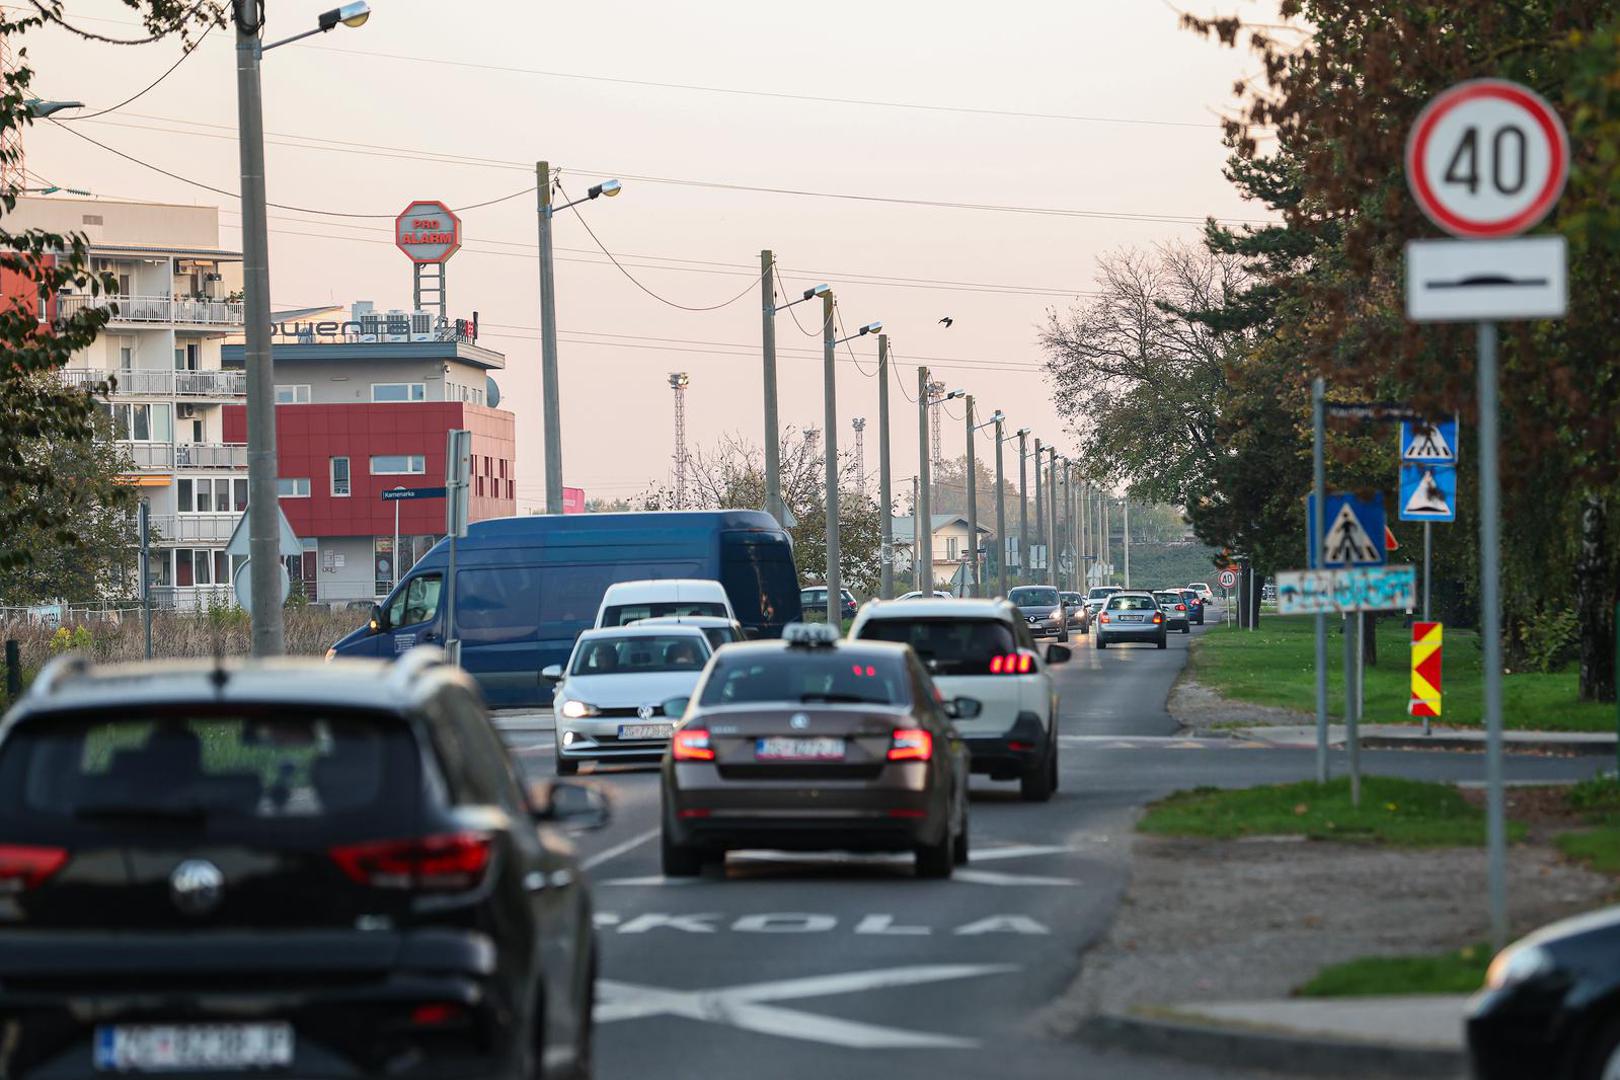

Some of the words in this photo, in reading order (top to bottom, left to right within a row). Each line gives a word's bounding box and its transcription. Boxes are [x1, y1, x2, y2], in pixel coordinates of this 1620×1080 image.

[1444, 123, 1527, 195] 40
[401, 231, 453, 244] ALARM
[1223, 574, 1233, 584] 40
[593, 912, 1050, 935] KOLA
